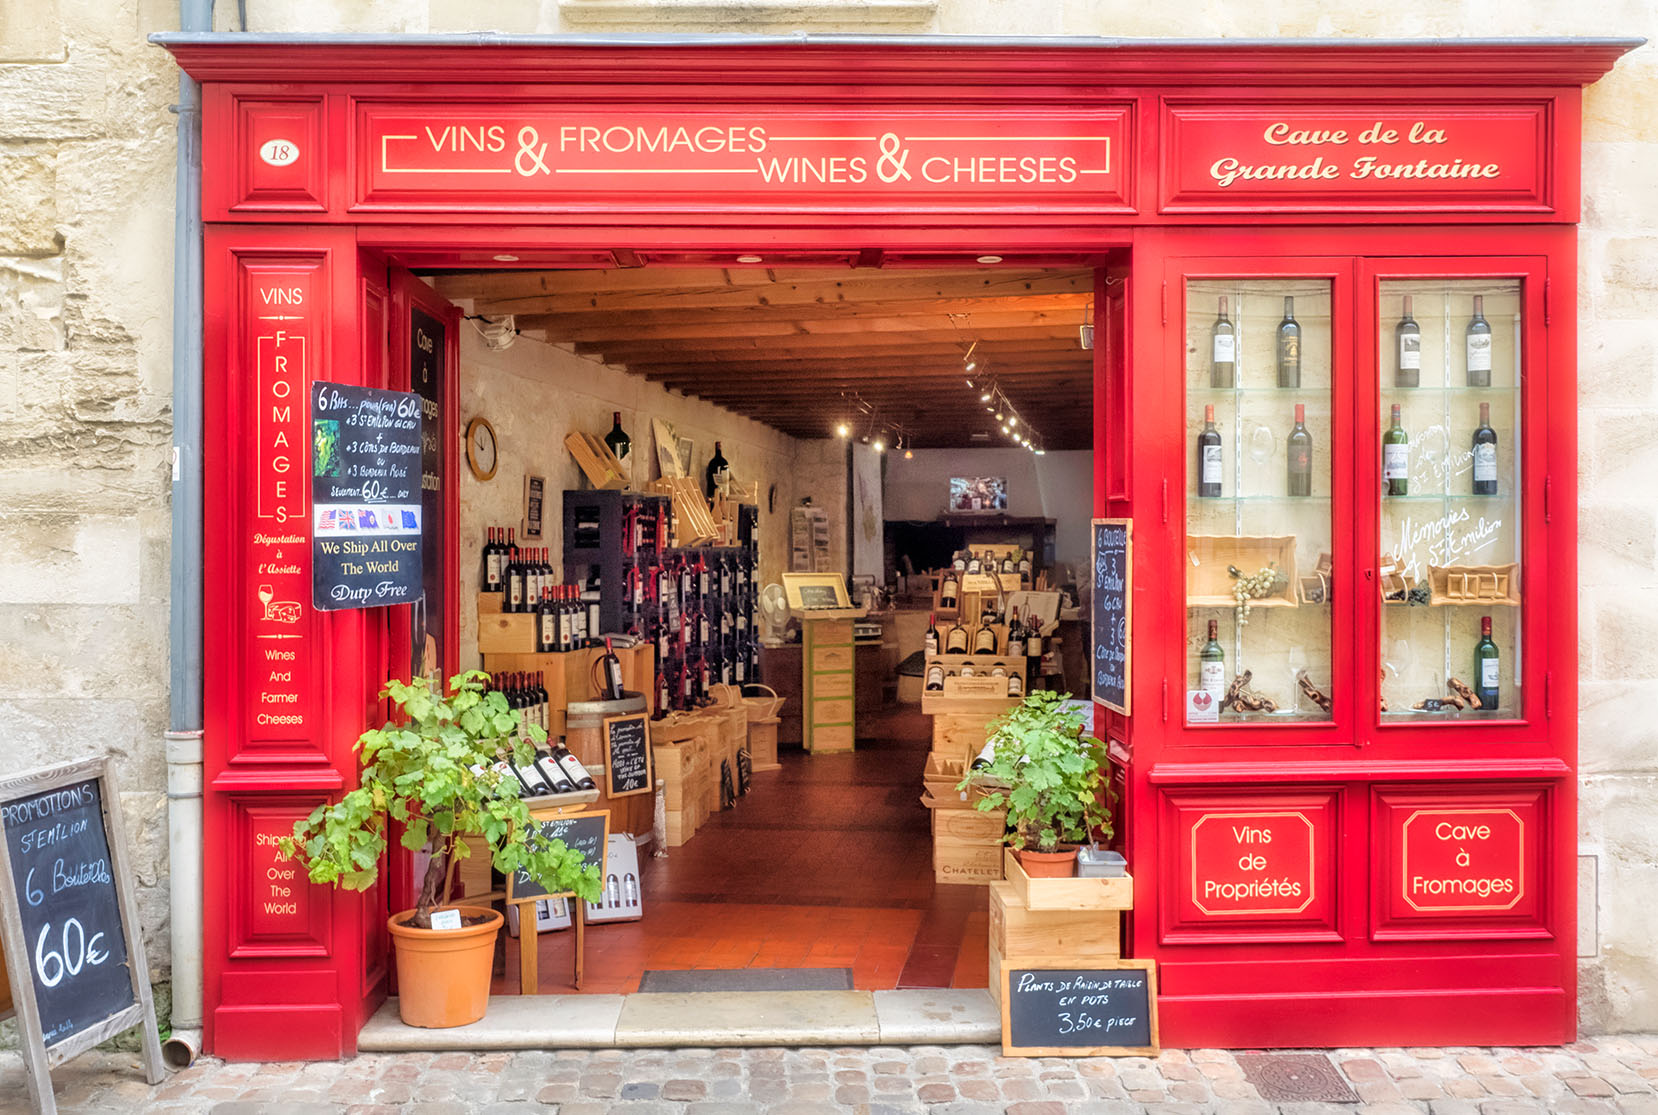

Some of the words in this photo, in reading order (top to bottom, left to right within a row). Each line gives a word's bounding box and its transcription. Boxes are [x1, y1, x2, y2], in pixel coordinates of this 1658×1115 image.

[1264, 122, 1349, 145] Cave
[1358, 122, 1399, 144] de
[1408, 122, 1447, 144] la
[270, 145, 289, 160] 18
[425, 126, 505, 152] VINS
[514, 126, 550, 176] &
[560, 126, 766, 153] FROMAGES
[758, 157, 867, 183] WINES
[877, 132, 912, 183] &
[921, 157, 1077, 183] CHEESES
[1210, 157, 1340, 187] Grande
[1350, 157, 1501, 179] Fontaine
[260, 288, 303, 305] VINS
[417, 328, 433, 354] Cave
[318, 386, 328, 411] 6
[398, 397, 421, 419] 60€
[273, 331, 290, 523] FROMAGES
[362, 480, 388, 499] 60€
[254, 533, 306, 546] Dégustation
[320, 541, 340, 555] We
[343, 541, 369, 556] Ship
[370, 541, 388, 553] All
[391, 540, 417, 552] Over
[341, 563, 363, 575] The
[366, 560, 399, 574] World
[331, 583, 372, 604] Duty
[376, 581, 408, 597] Free
[265, 650, 295, 661] Wines
[269, 671, 291, 681] And
[261, 692, 298, 703] Farmer
[257, 713, 303, 725] Cheeses
[1, 784, 94, 826] PROMOTIONS
[37, 819, 88, 849] EMILION
[1232, 826, 1272, 844] Vins
[1435, 822, 1491, 840] Cave
[1239, 853, 1267, 871] de
[1456, 848, 1470, 867] à
[266, 867, 295, 880] Over
[943, 865, 999, 876] CHATELET
[25, 867, 44, 906] 6
[270, 885, 291, 897] The
[1205, 877, 1301, 901] Propriétés
[1413, 876, 1513, 898] Fromages
[264, 902, 297, 914] World
[35, 918, 110, 987] 60€
[1017, 973, 1053, 993] PLANTS
[1056, 981, 1071, 993] DE
[1059, 996, 1076, 1007] EN
[1081, 995, 1109, 1006] POTS
[1058, 1012, 1102, 1034] 3.50€
